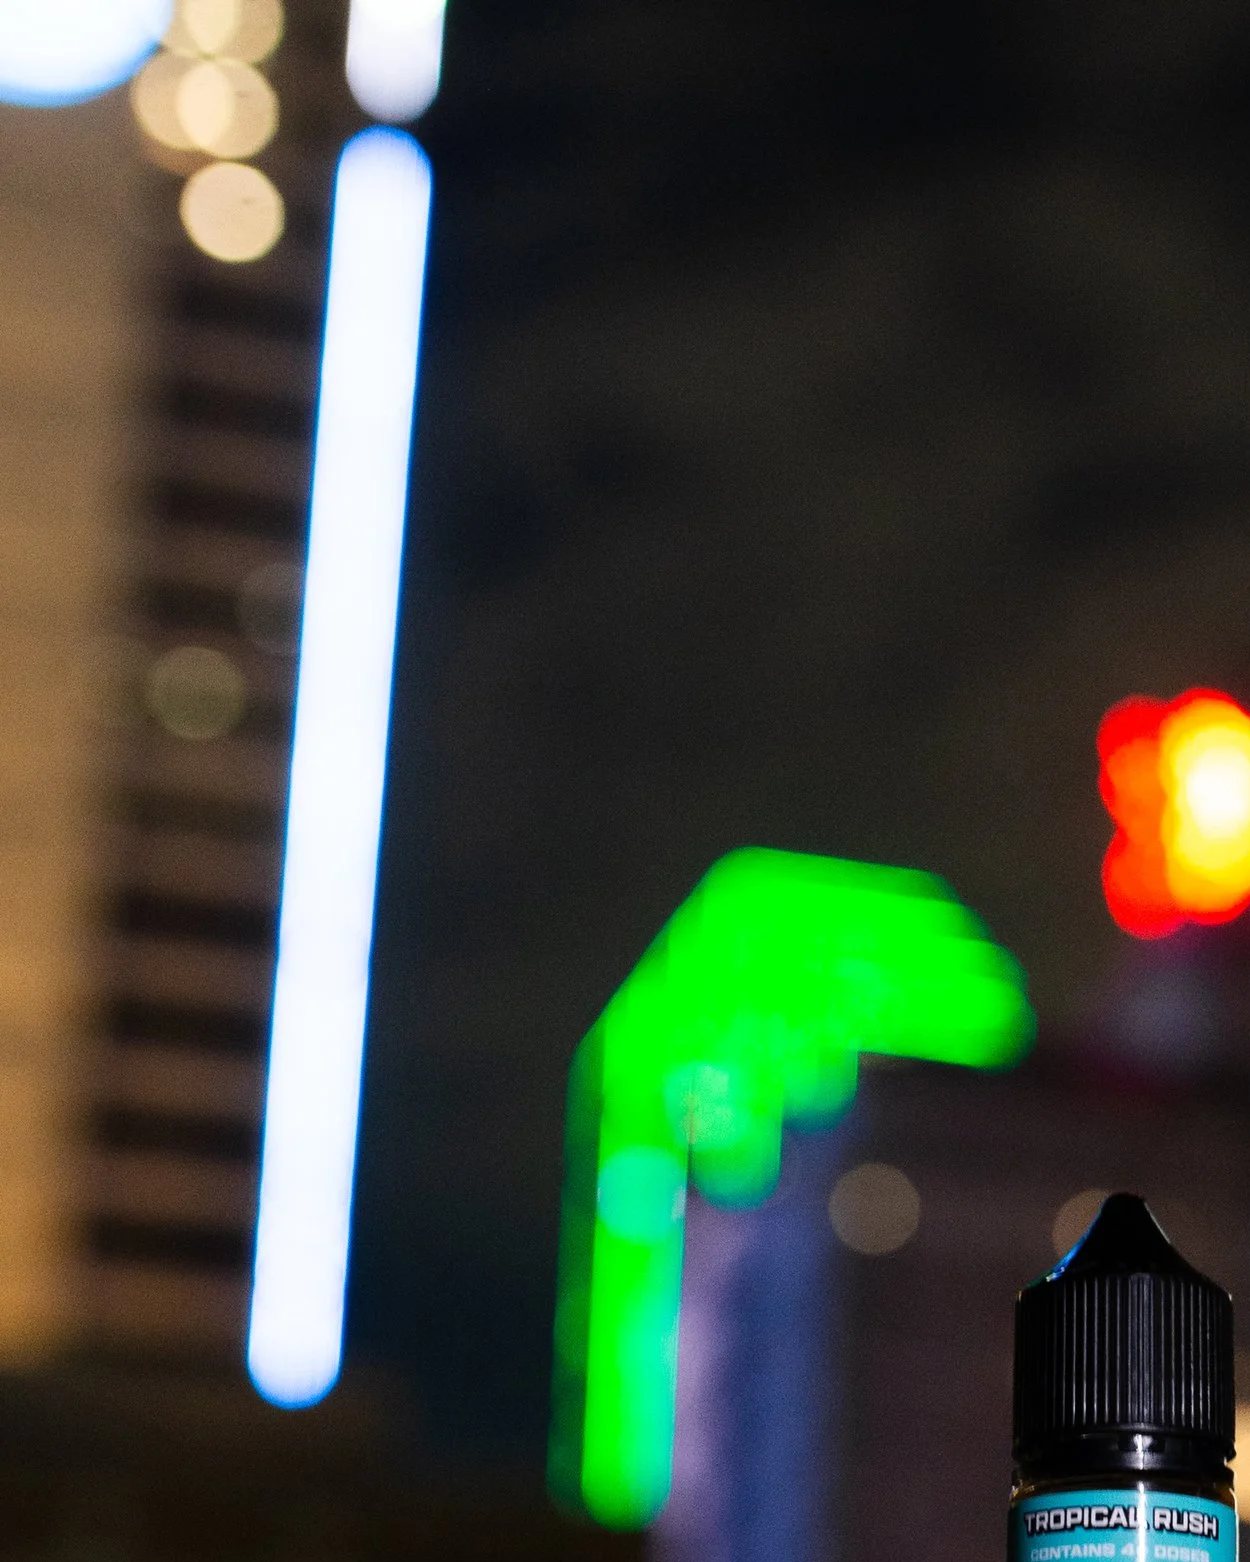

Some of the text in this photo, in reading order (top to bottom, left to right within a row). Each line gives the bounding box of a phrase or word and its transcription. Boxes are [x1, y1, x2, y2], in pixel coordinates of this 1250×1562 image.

[1025, 1505, 1219, 1539] TROPICAL RUSH
[1030, 1543, 1115, 1562] CONTAINS
